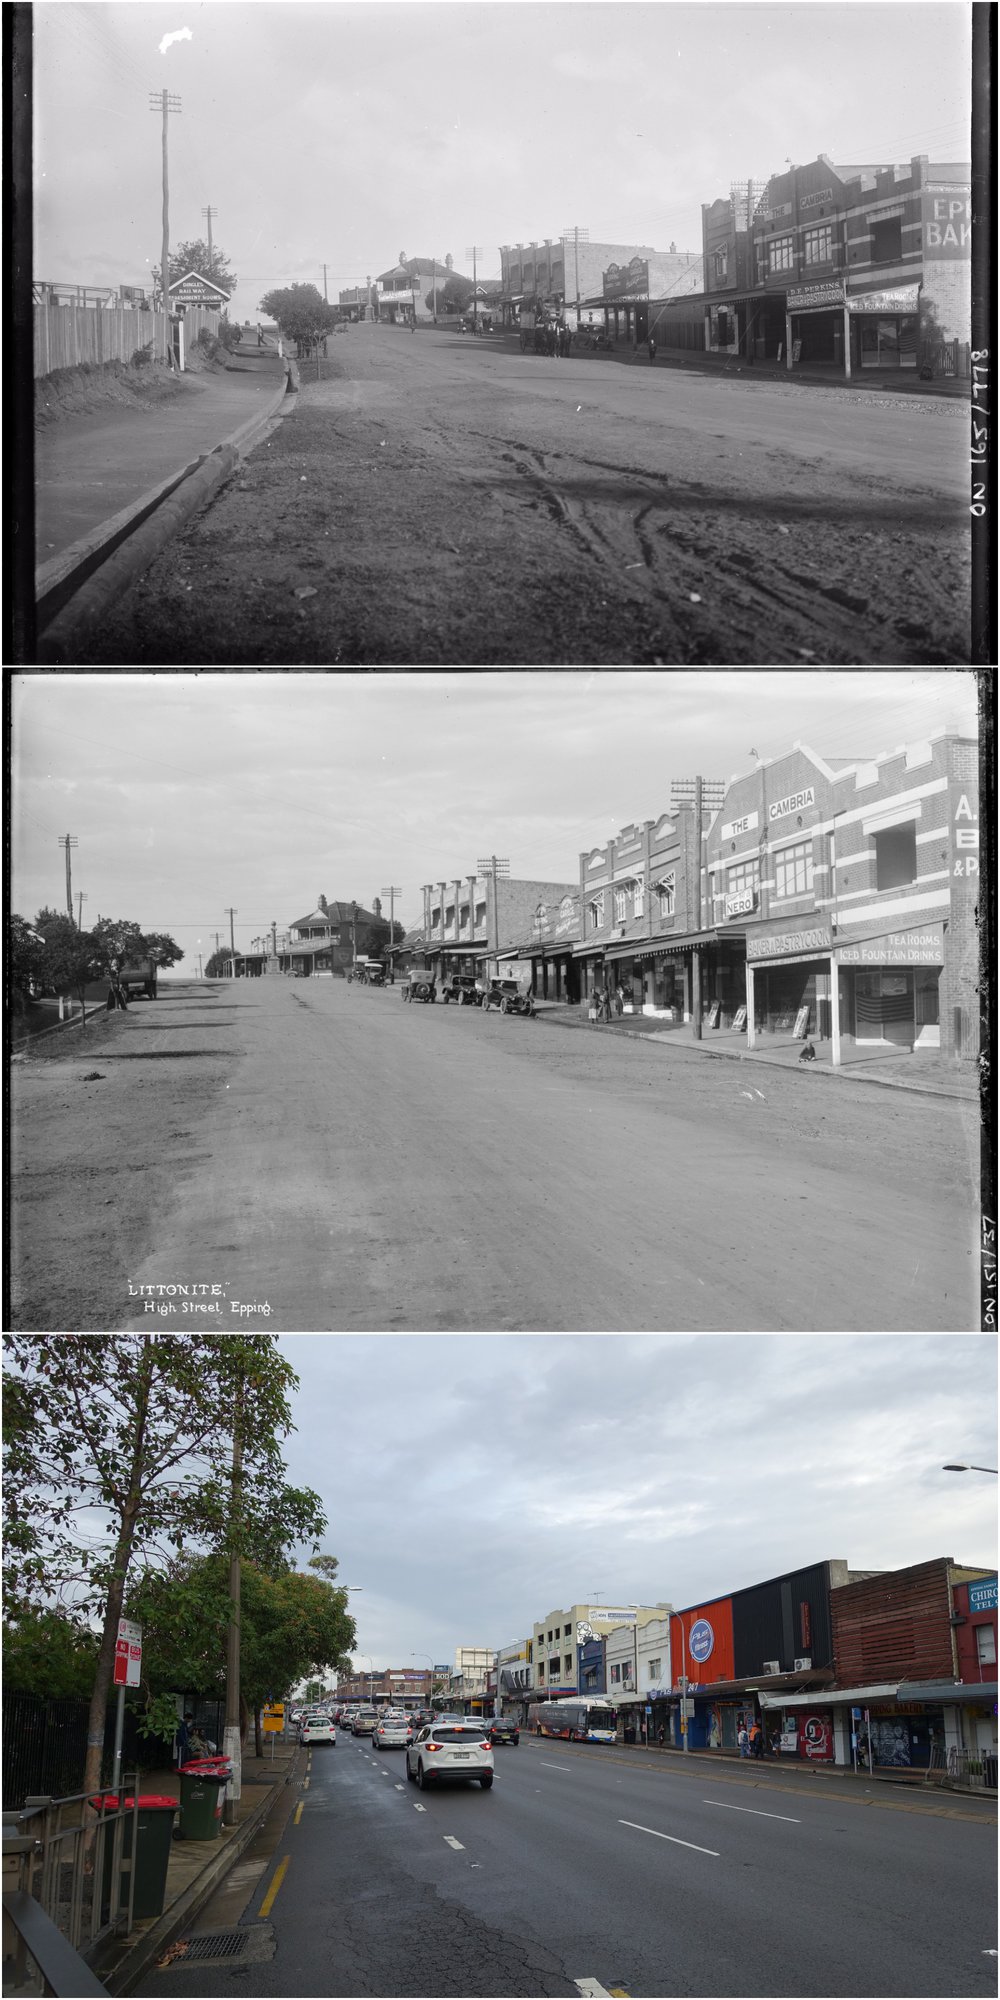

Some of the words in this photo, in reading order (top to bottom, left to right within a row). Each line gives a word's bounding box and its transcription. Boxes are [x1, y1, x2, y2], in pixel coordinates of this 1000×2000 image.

[800, 189, 833, 209] CAMBRIA
[804, 281, 840, 294] PERKINS
[770, 789, 814, 819] CAMBRIA
[731, 817, 748, 835] THE
[727, 898, 751, 914] NERO
[888, 934, 908, 945] TEA
[907, 933, 940, 946] ROOMS
[840, 949, 860, 961] ICED
[862, 949, 906, 961] FOUNTAIN
[907, 949, 942, 961] DRINKS
[975, 1600, 994, 1610] TEL
